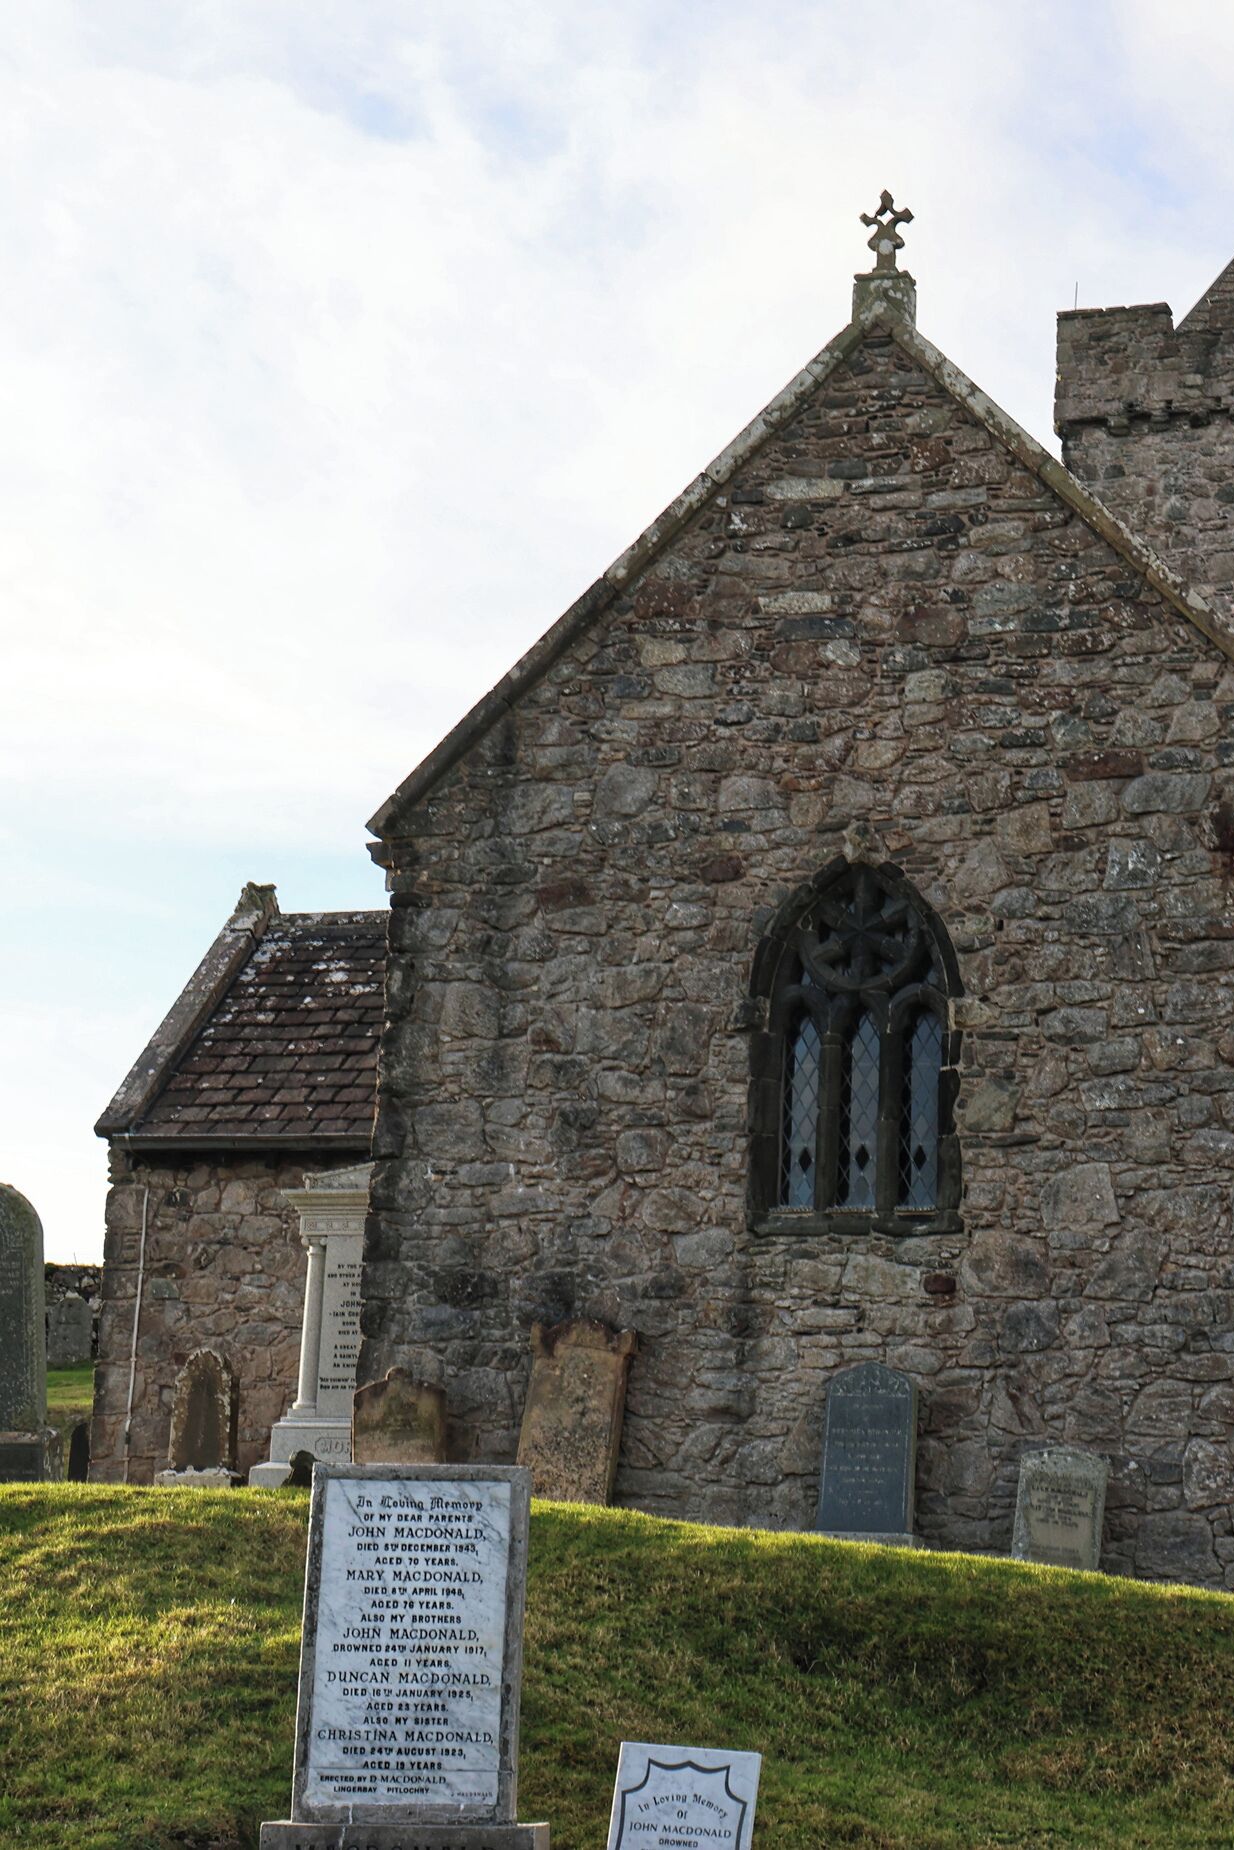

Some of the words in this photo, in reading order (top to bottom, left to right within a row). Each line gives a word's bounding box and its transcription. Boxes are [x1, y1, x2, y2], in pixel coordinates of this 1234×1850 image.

[357, 1496, 372, 1509] In
[380, 1496, 424, 1510] Loving
[430, 1496, 482, 1511] Memory
[397, 1514, 423, 1522] DEAR
[429, 1514, 473, 1523] PARENTS
[348, 1527, 386, 1538] JOHN
[394, 1527, 486, 1541] MACDONALD,
[357, 1543, 379, 1551] DIED
[401, 1544, 450, 1553] DECEMBER
[375, 1557, 402, 1566] AGED
[408, 1558, 419, 1566] 70
[425, 1557, 459, 1567] YEARS.
[346, 1571, 385, 1581] MARY
[393, 1571, 484, 1584] MACDONALD,
[364, 1586, 387, 1595] DIED
[412, 1588, 438, 1596] APRIL
[371, 1600, 399, 1609] AGED
[419, 1601, 455, 1610] YEARS.
[360, 1614, 385, 1623] ALSO
[390, 1614, 405, 1623] MY
[411, 1615, 462, 1624] BROTHERS
[343, 1628, 381, 1639] JOHN
[390, 1628, 480, 1642] MACDONALD,
[333, 1644, 382, 1653] DROWNED
[409, 1645, 459, 1654] JANUARY
[369, 1659, 398, 1667] AGED
[327, 1671, 390, 1683] DUNCAN
[398, 1672, 491, 1686] MACDONALD,
[342, 1688, 367, 1697] DIED
[395, 1689, 443, 1698] JANUARY
[366, 1702, 393, 1711] AGED
[363, 1716, 388, 1725] ALSO
[395, 1717, 409, 1725] MY
[414, 1717, 449, 1726] SISTER
[317, 1729, 398, 1741] CHRISTINA
[404, 1730, 494, 1744] MACDONALD,
[342, 1747, 366, 1755] DIED
[395, 1747, 436, 1756] AUGUST
[363, 1761, 391, 1770] AGED
[396, 1761, 405, 1770] 19
[410, 1761, 442, 1770] YEARS
[320, 1775, 355, 1783] ERECTED
[357, 1775, 367, 1783] BY
[380, 1775, 447, 1785] MACDONALD
[333, 1786, 378, 1794] LINGERBAY
[387, 1787, 430, 1795] PITLOCHRY
[638, 1803, 650, 1813] In
[653, 1794, 688, 1806] Loving
[693, 1793, 728, 1820] Memory
[630, 1821, 658, 1833] JOHN
[662, 1824, 732, 1839] MACDONALD
[658, 1838, 698, 1849] DROWNED
